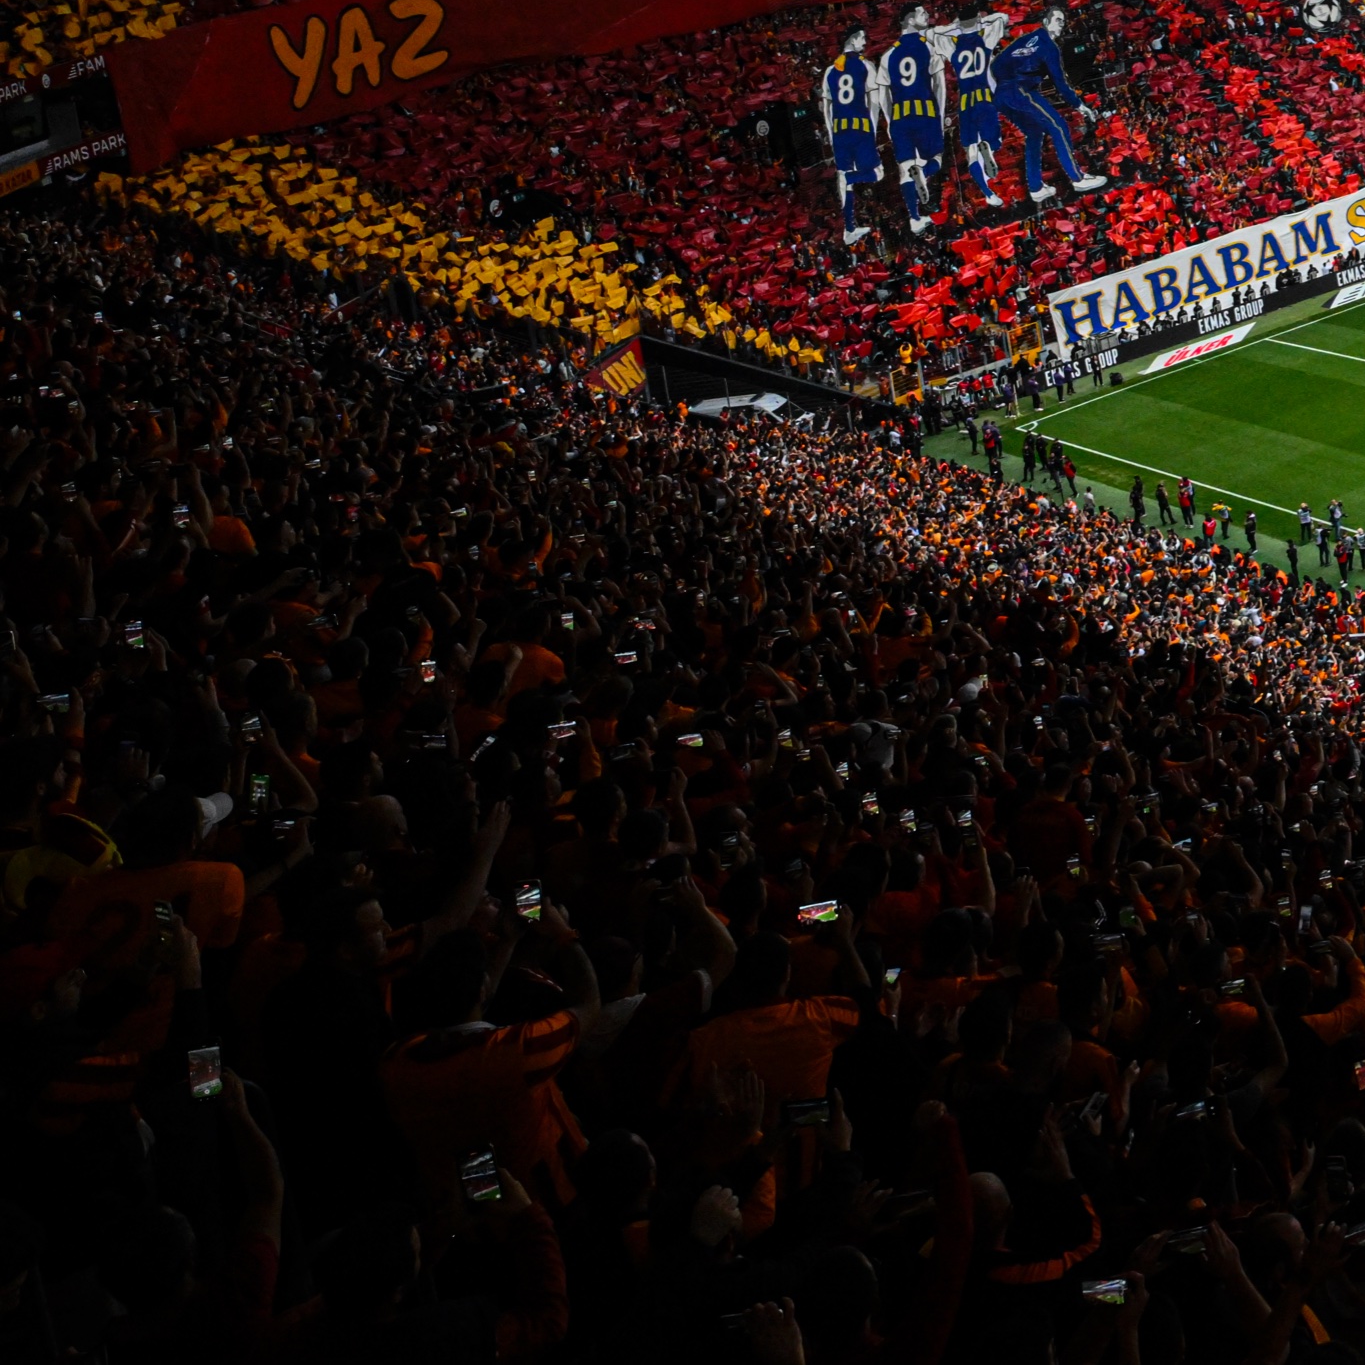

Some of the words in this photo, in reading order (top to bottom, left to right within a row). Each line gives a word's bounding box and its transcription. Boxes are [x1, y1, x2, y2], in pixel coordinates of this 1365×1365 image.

[898, 56, 918, 87] 9
[957, 47, 987, 80] 20
[837, 73, 855, 105] 8
[53, 145, 90, 170] RAMS
[91, 133, 128, 157] PARK
[1054, 211, 1342, 348] HABABAM
[1198, 314, 1231, 335] EKMAS
[1234, 297, 1265, 322] GROUP
[1163, 333, 1235, 368] ÜLKER
